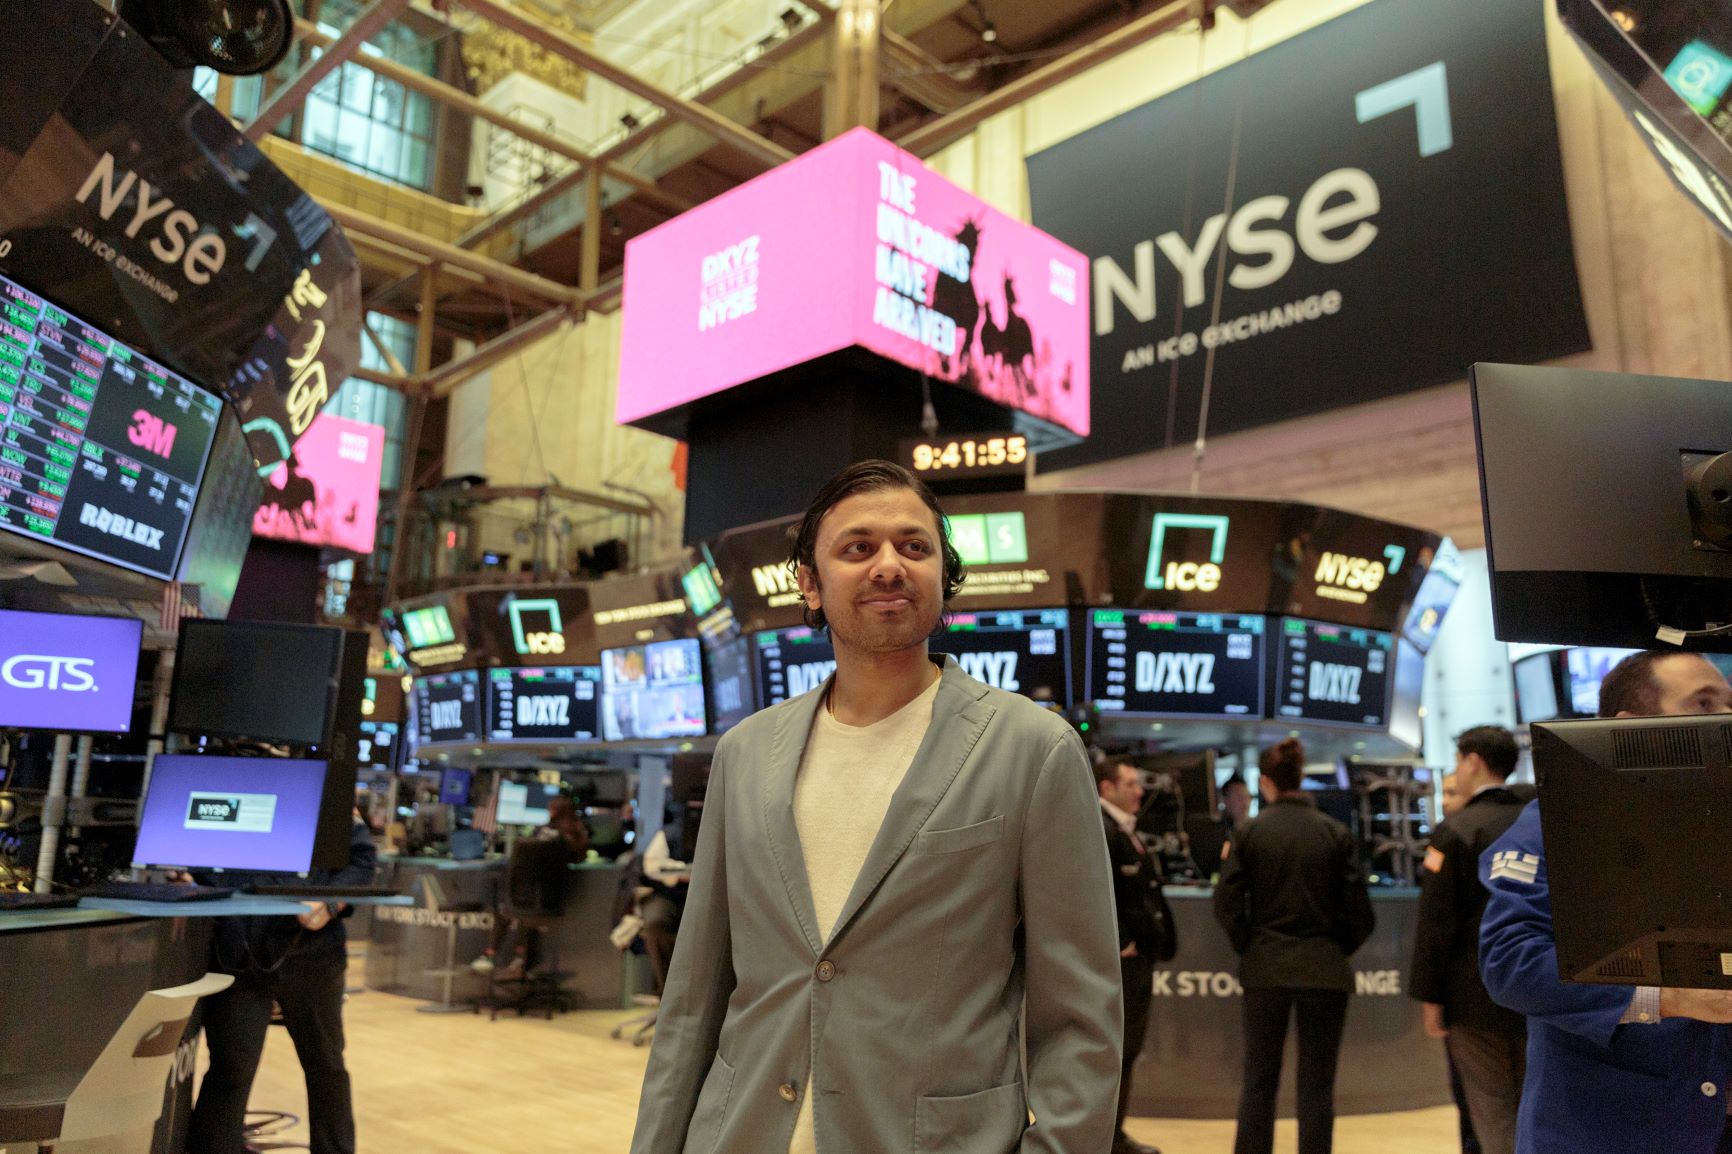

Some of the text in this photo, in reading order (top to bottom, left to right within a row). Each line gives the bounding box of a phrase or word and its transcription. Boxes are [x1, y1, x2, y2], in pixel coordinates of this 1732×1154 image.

[878, 161, 917, 215] THE
[71, 227, 94, 247] AN
[702, 235, 760, 283] DXYZ
[876, 201, 970, 283] UNICORNS
[875, 243, 927, 303] HAVE
[699, 284, 758, 332] NYSE
[873, 286, 956, 356] ARRIVED
[1121, 344, 1155, 373] AN
[127, 409, 177, 460] 3M
[912, 436, 1027, 471] 9:41:55
[80, 503, 165, 550] ROBLOX
[1135, 651, 1216, 694] D/XYZ
[1308, 661, 1363, 705] D/XYZ
[516, 695, 570, 726] D/XYZ
[1152, 969, 1402, 997] K STO NGE
